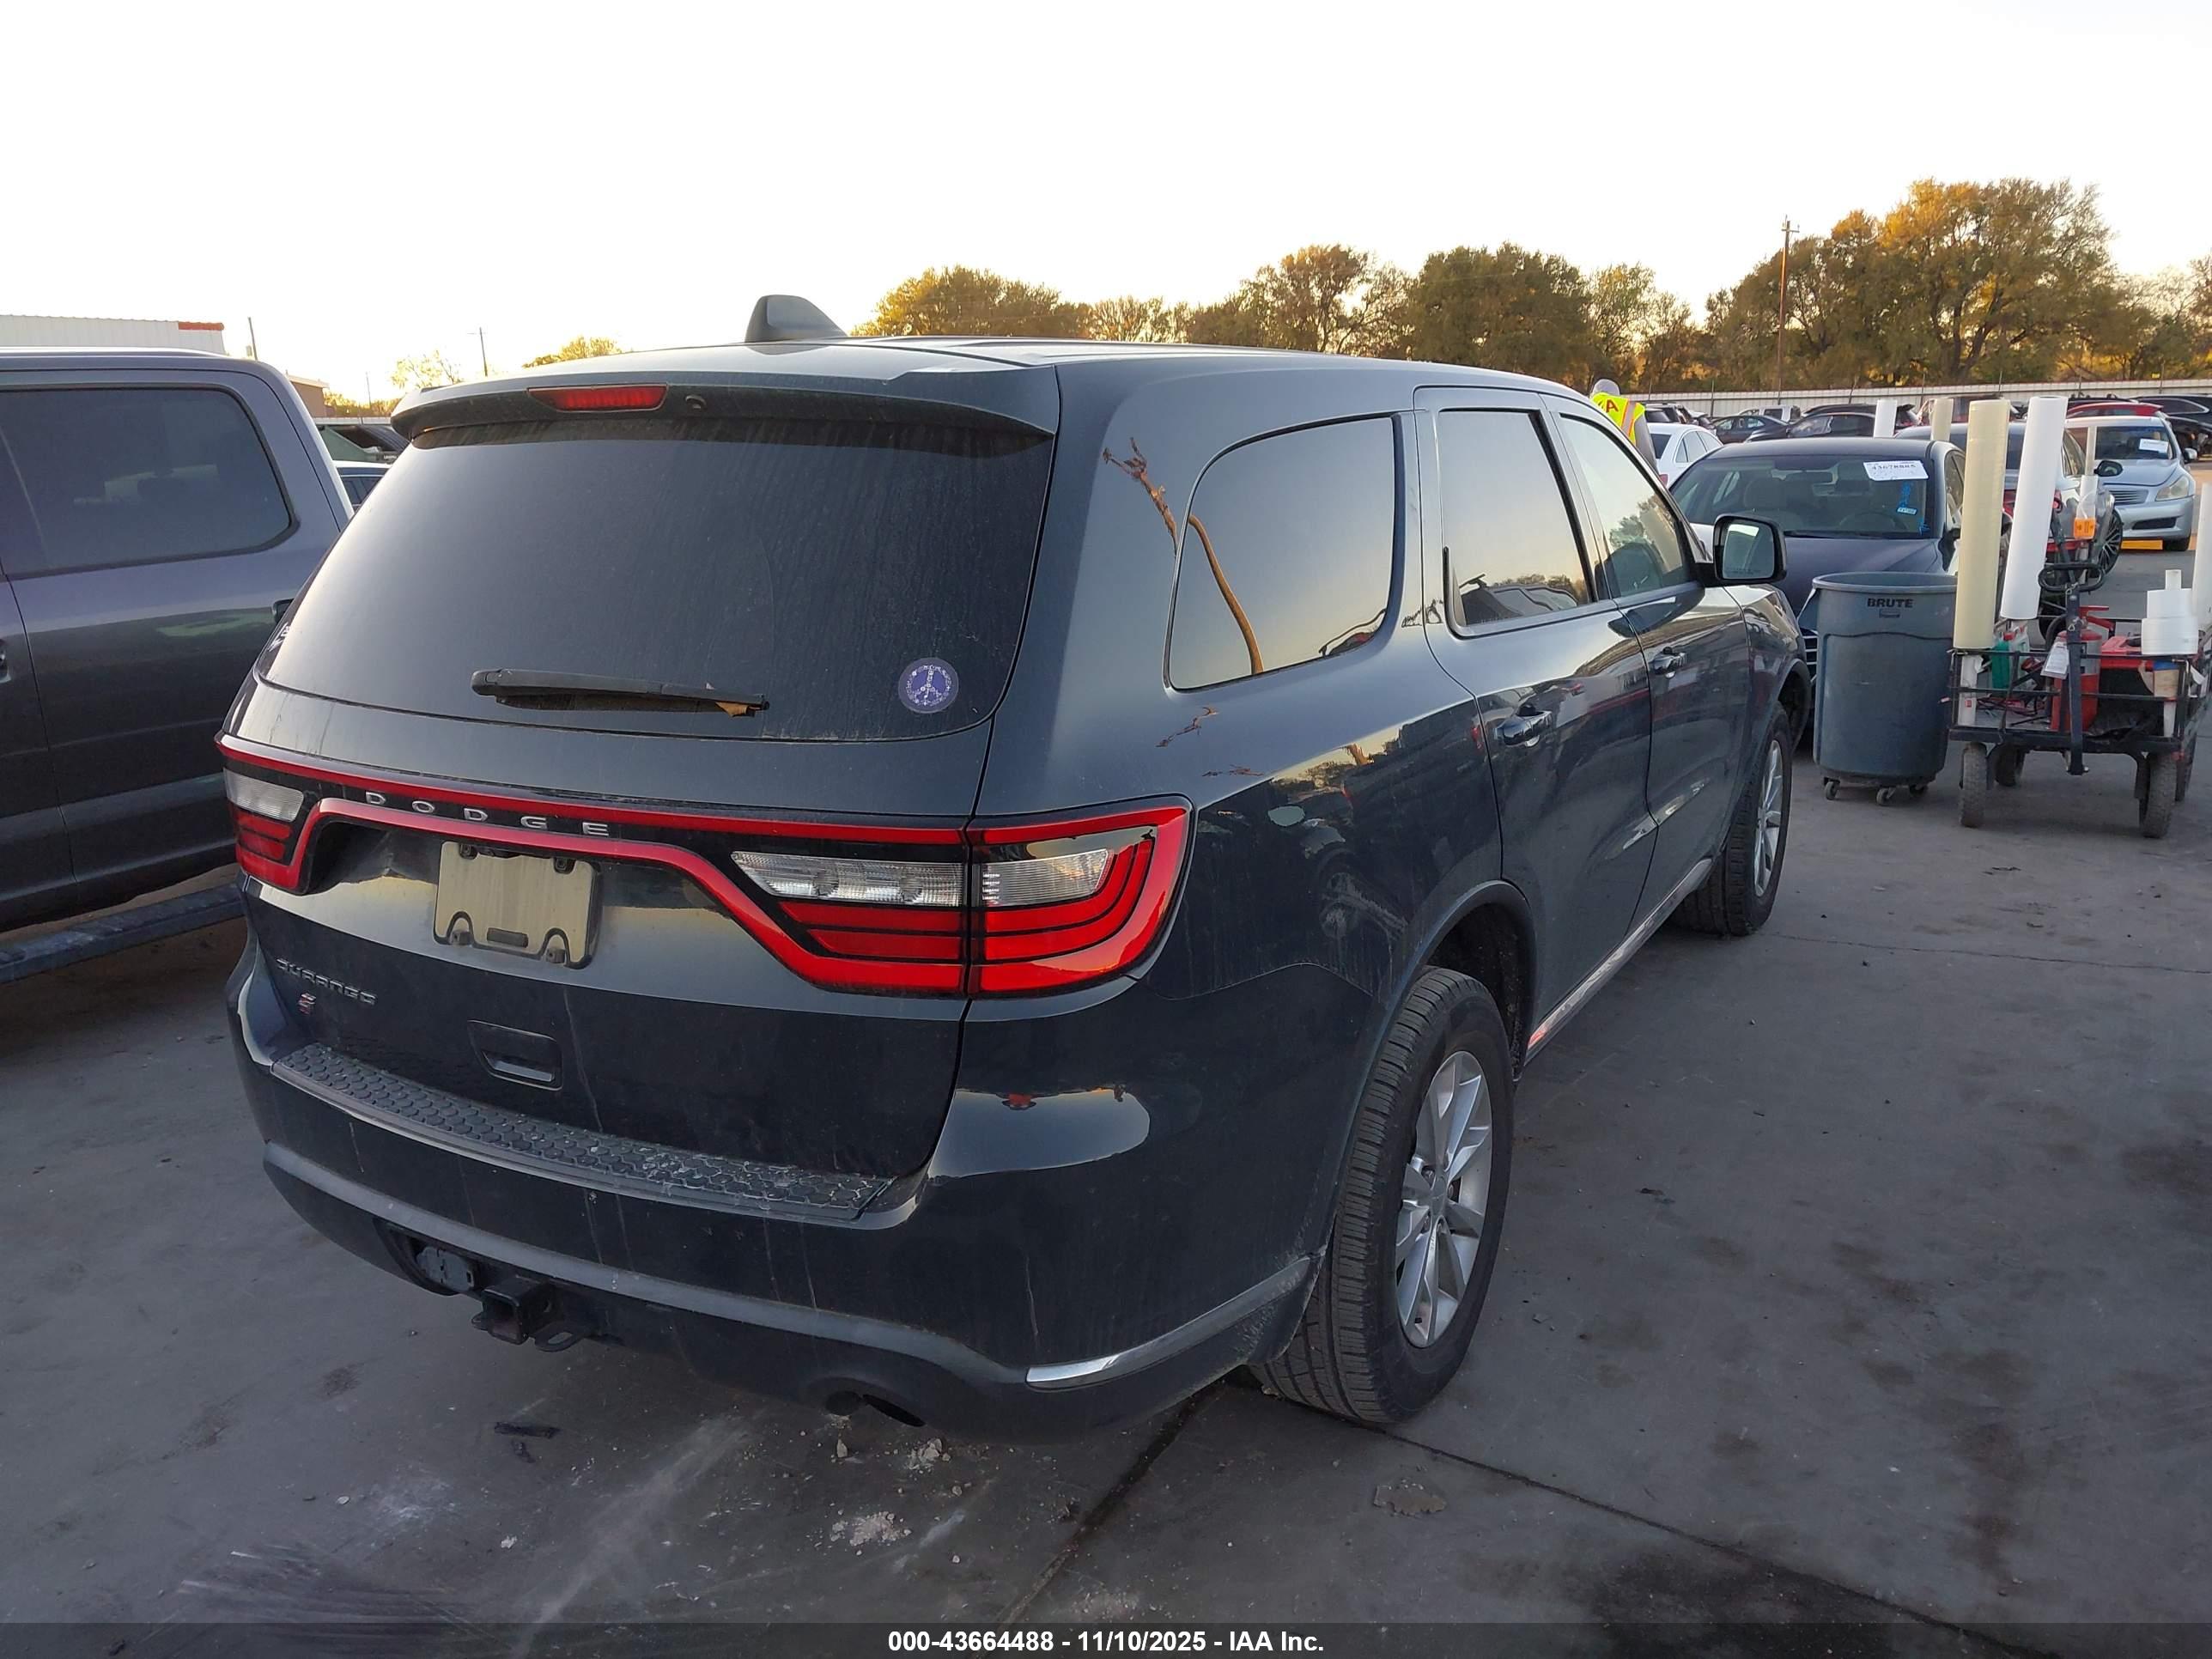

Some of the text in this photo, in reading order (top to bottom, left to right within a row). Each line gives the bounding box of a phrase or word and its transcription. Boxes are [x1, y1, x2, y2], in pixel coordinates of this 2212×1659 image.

[1867, 598, 1914, 608] BRUTE
[365, 791, 609, 836] DODGE
[276, 958, 378, 1006] DURANGO
